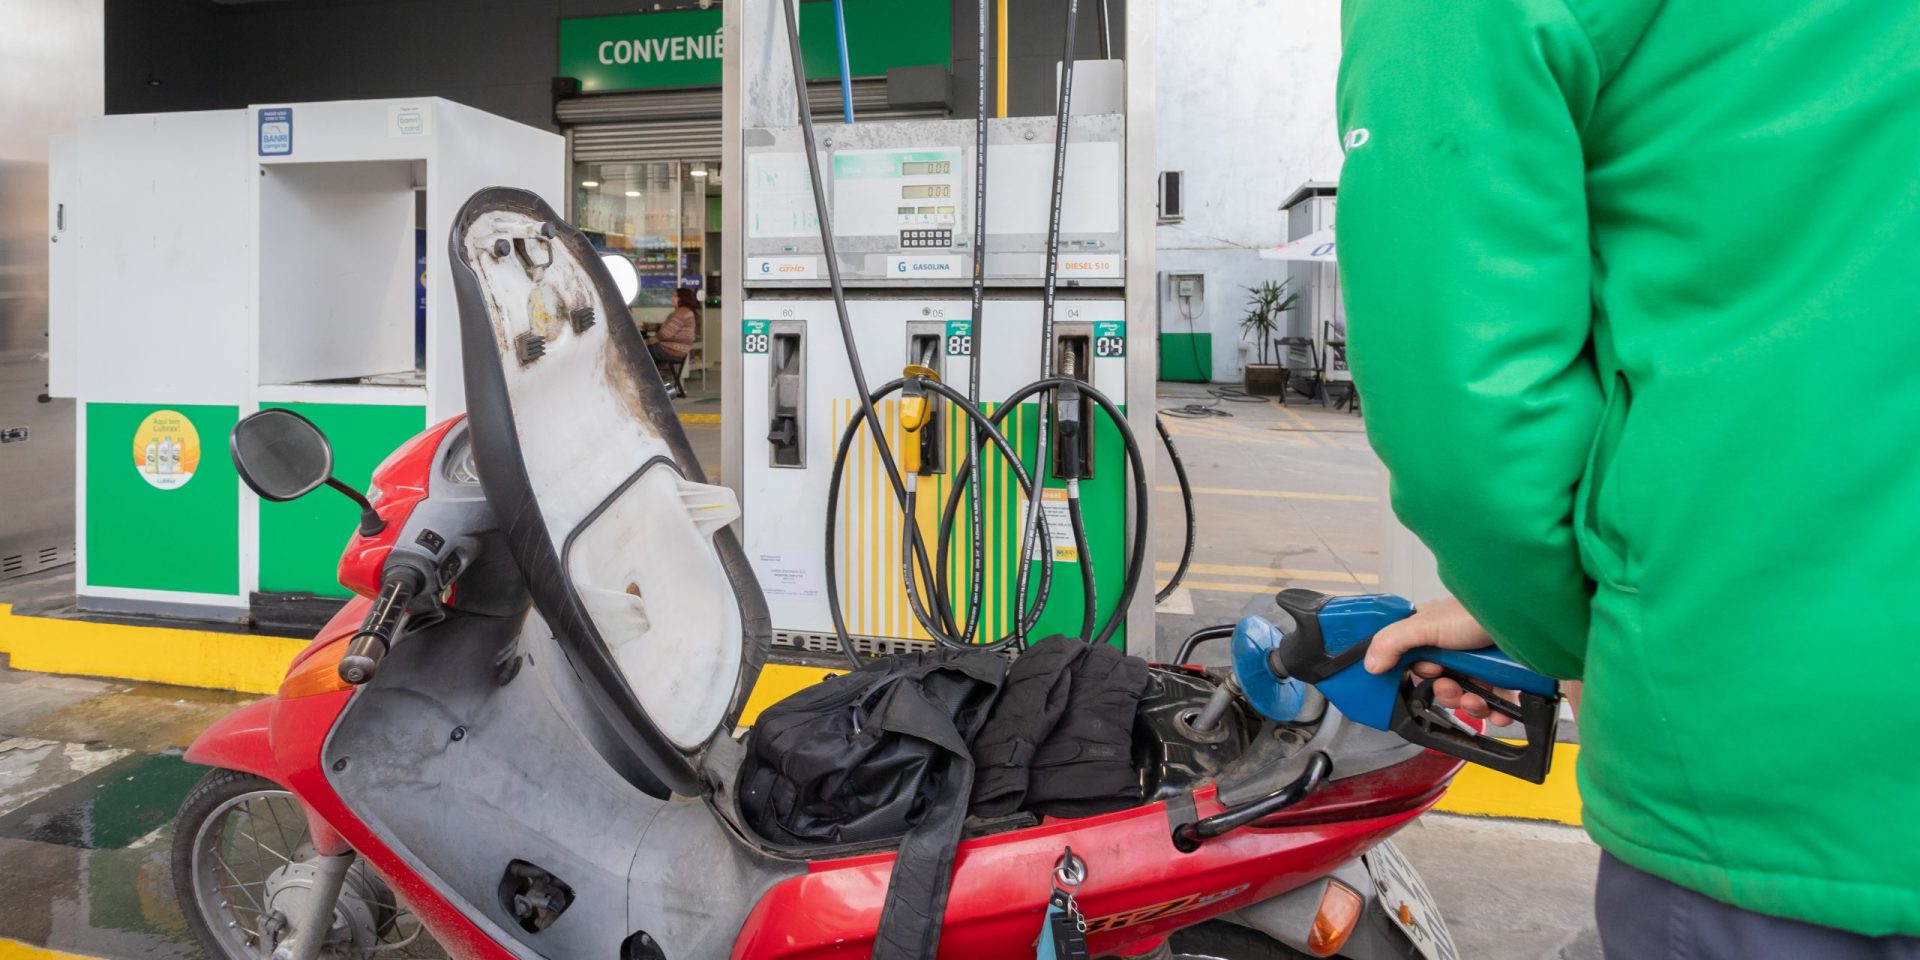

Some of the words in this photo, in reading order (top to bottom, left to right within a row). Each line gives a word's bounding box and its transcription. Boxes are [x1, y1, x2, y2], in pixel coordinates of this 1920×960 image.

[598, 27, 723, 64] CONVENIÊ
[761, 262, 770, 273] G
[898, 261, 906, 272] G
[912, 263, 950, 271] GASOLINA
[1065, 262, 1093, 270] DIESEL
[1095, 262, 1110, 270] S10
[782, 308, 793, 317] 60
[932, 309, 944, 318] 05
[1067, 309, 1079, 318] 04
